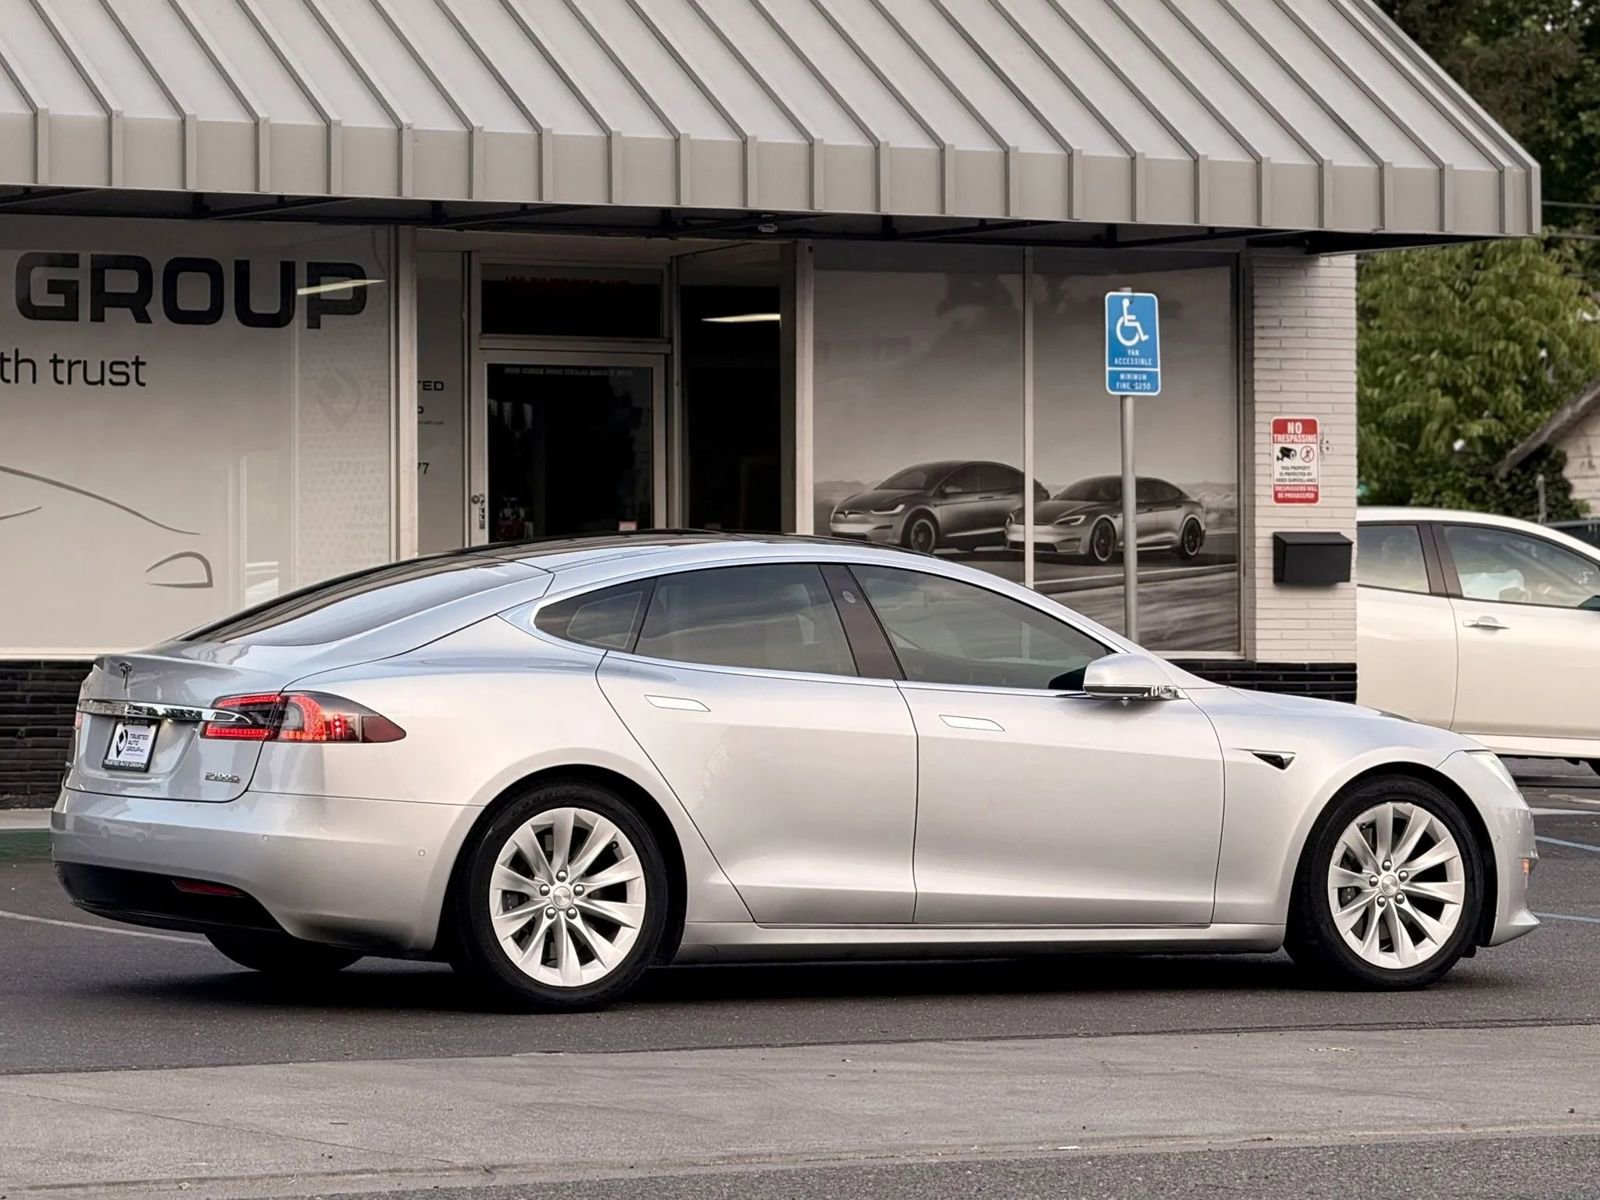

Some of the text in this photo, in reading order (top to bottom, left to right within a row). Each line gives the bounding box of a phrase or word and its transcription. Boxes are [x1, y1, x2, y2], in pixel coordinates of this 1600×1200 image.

[15, 252, 367, 329] GROUP
[1114, 358, 1152, 366] ACCESSIBLE
[49, 353, 147, 387] trust
[1287, 421, 1302, 434] NO
[1273, 434, 1317, 443] TRESPASSING
